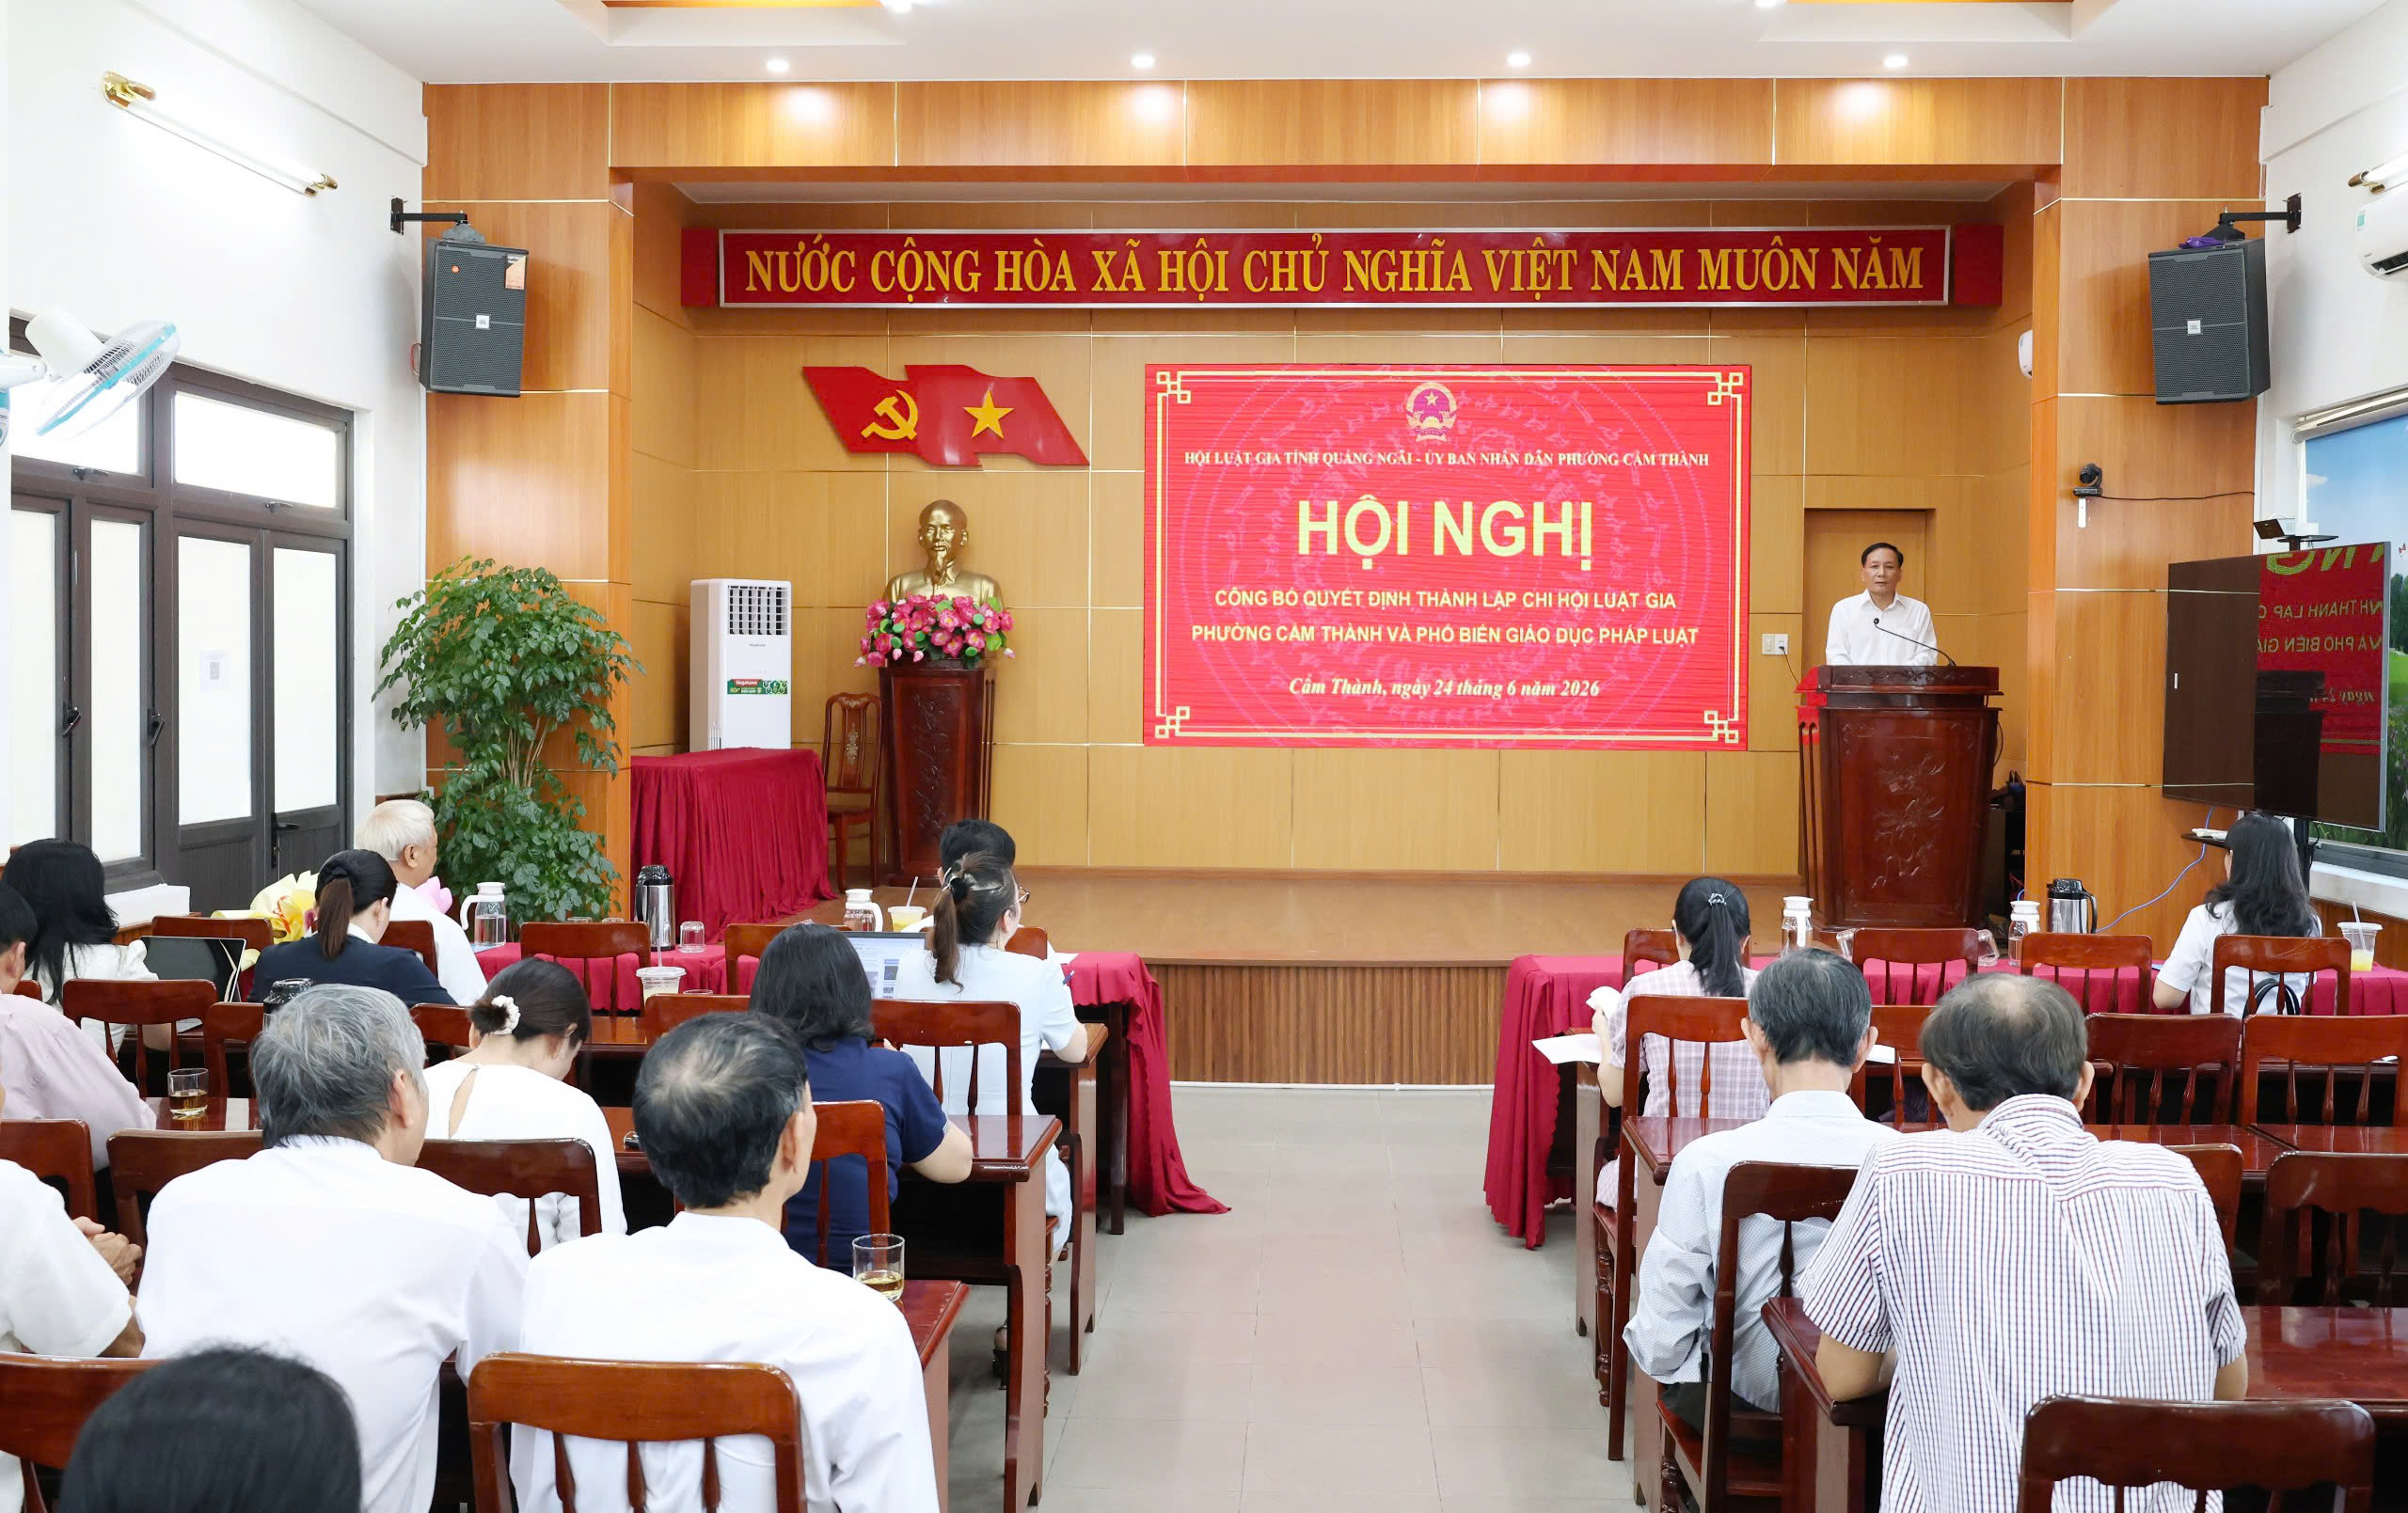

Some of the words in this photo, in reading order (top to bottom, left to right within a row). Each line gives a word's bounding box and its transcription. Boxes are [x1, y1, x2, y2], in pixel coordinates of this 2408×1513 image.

[745, 232, 855, 292] NƯỚC
[870, 237, 982, 302] CỘNG
[993, 238, 1077, 292] HÒA
[1091, 239, 1145, 292] XÃ
[1157, 238, 1229, 302] HỘI
[1243, 232, 1329, 292] CHỦ
[1342, 239, 1473, 292] NGHĨA
[1481, 236, 1577, 300] VIỆT
[1591, 248, 1685, 291] NAM
[1697, 236, 1819, 292] MUÔN
[1830, 237, 1925, 290] NĂM
[1184, 449, 1211, 467] HỘI
[1214, 450, 1252, 467] LUẬT
[1255, 452, 1281, 465] GIA
[1322, 449, 1373, 467] QUẢNG
[1376, 449, 1413, 465] NGÃI
[1448, 452, 1477, 465] BAN
[1480, 449, 1520, 465] NHÂN
[1524, 449, 1554, 466] DÂN
[1558, 450, 1619, 466] PHƯỜNG
[1659, 450, 1710, 466] THÀNH
[1298, 494, 1409, 570] HỘI
[1434, 500, 1592, 572] NGHỊ
[1214, 587, 1268, 607] CÔNG
[1368, 591, 1412, 610] ĐỊNH
[1416, 588, 1478, 607] THÀNH
[1522, 591, 1554, 608] CHI
[1557, 590, 1590, 612] HỘI
[1645, 592, 1677, 609] GIA
[1192, 623, 1272, 642] PHƯỜNG
[1320, 622, 1383, 642] THÀNH
[1386, 623, 1413, 642] VÀ
[1505, 623, 1551, 644] GIÁO
[1555, 627, 1595, 648] DỤC
[1599, 624, 1649, 644] PHÁP
[1331, 678, 1387, 697] Thành,
[1391, 679, 1431, 700] ngày
[1433, 679, 1453, 696] 24
[1456, 679, 1502, 700] tháng
[1506, 680, 1517, 696] 6
[1520, 680, 1557, 697] năm
[1560, 680, 1600, 697] 2026
